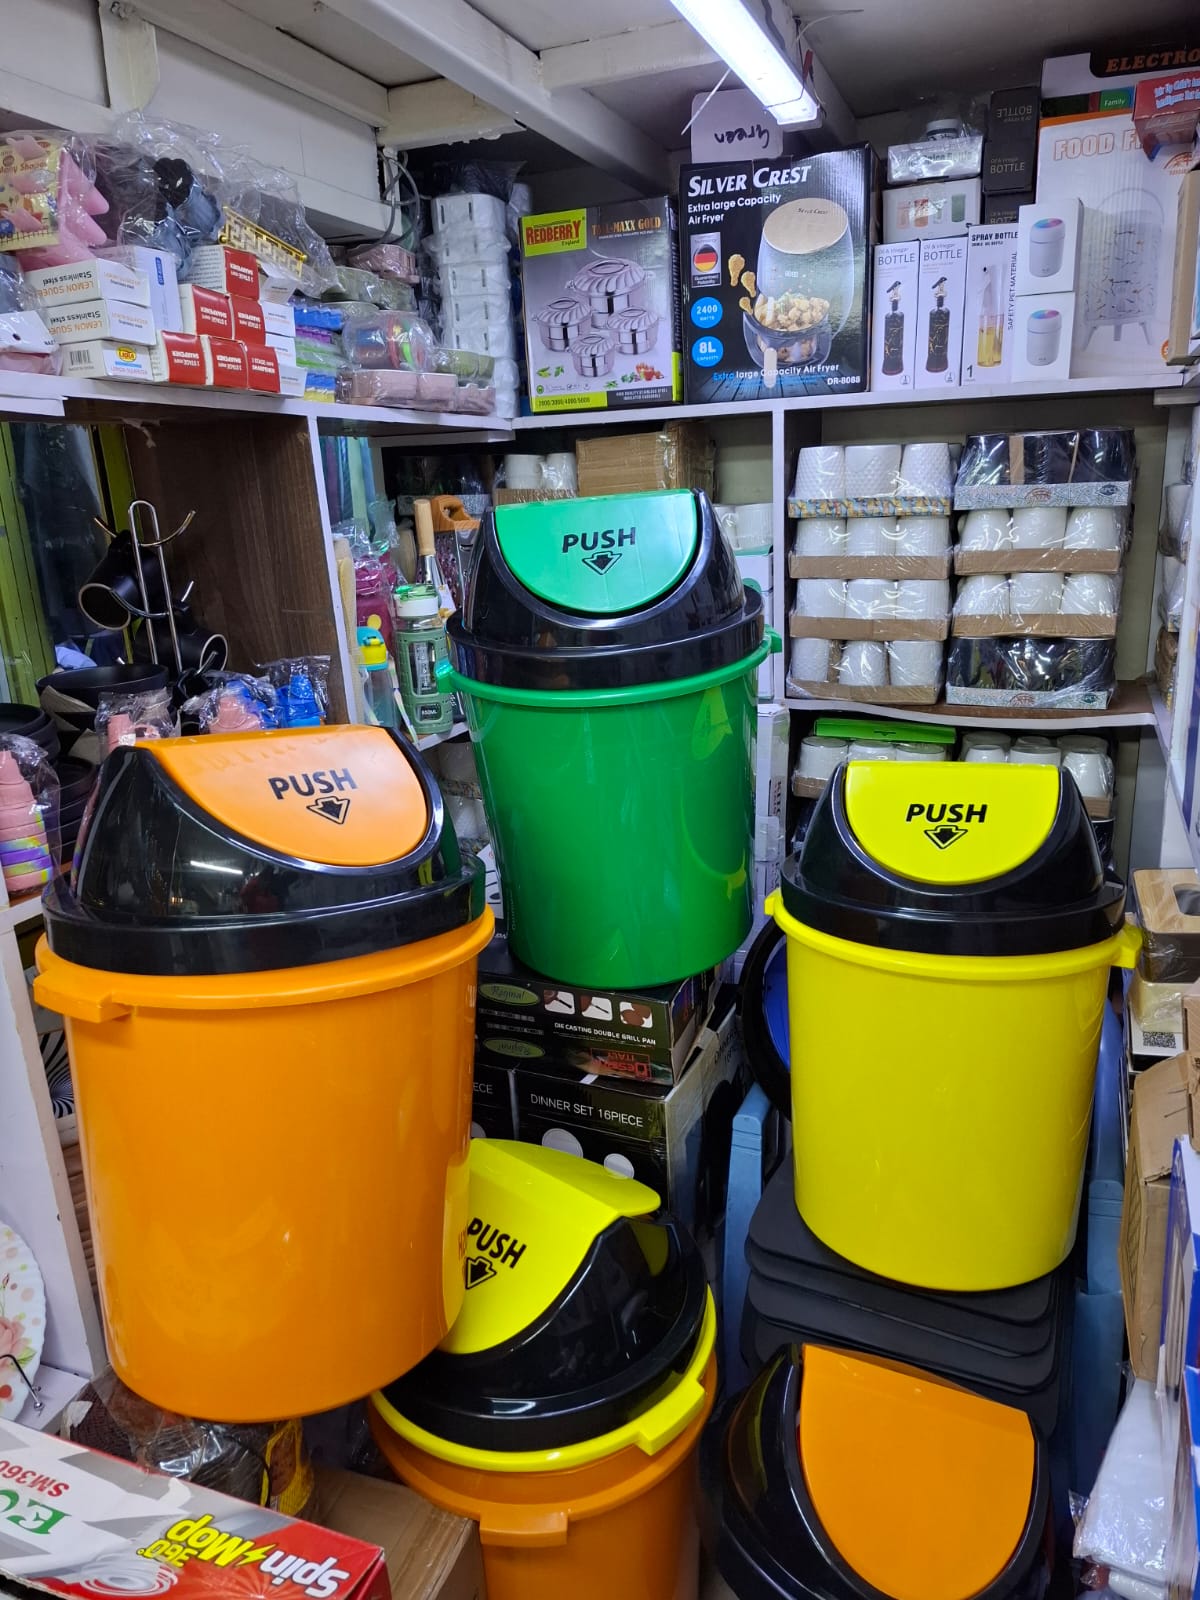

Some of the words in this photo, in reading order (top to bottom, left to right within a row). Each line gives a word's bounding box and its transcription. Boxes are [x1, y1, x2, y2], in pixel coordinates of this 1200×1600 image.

[1106, 49, 1200, 72] ELECTRO
[997, 106, 1032, 118] BOTTLE
[714, 124, 770, 148] Green
[1054, 133, 1114, 161] FOOD
[990, 162, 1024, 174] BOTTLE
[688, 174, 747, 196] SILVER
[753, 166, 811, 188] CREST
[688, 203, 710, 213] Extra
[712, 199, 736, 210] large
[738, 193, 781, 206] Capacity
[638, 217, 660, 230] GOLD
[688, 216, 701, 225] Air
[702, 213, 724, 225] Fryer
[526, 220, 581, 246] REDBERRY
[972, 233, 993, 241] SPRAY
[995, 232, 1018, 240] BOTTLE
[878, 253, 915, 265] BOTTLE
[924, 249, 962, 261] BOTTLE
[43, 278, 58, 286] steel
[59, 271, 92, 281] Stainless
[66, 281, 93, 291] LEMON
[67, 311, 101, 321] Stainless
[697, 305, 717, 315] 2400
[75, 321, 102, 331] LEMON
[700, 341, 716, 353] 8L
[713, 372, 734, 381] Extra
[736, 370, 758, 380] large
[761, 367, 800, 377] Capacity
[804, 366, 815, 374] Air
[818, 365, 839, 375] Fryer
[562, 527, 636, 553] PUSH
[268, 768, 358, 800] PUSH
[906, 804, 988, 823] PUSH
[565, 1024, 592, 1034] CASTING
[594, 1029, 620, 1039] DOUBLE
[622, 1034, 640, 1042] GRILL
[531, 1093, 570, 1112] DINNER
[573, 1104, 594, 1116] SET
[598, 1108, 644, 1127] 16PIECE
[467, 1217, 527, 1268] PUSH
[166, 1514, 255, 1567] Mop
[260, 1550, 350, 1598] Spin
